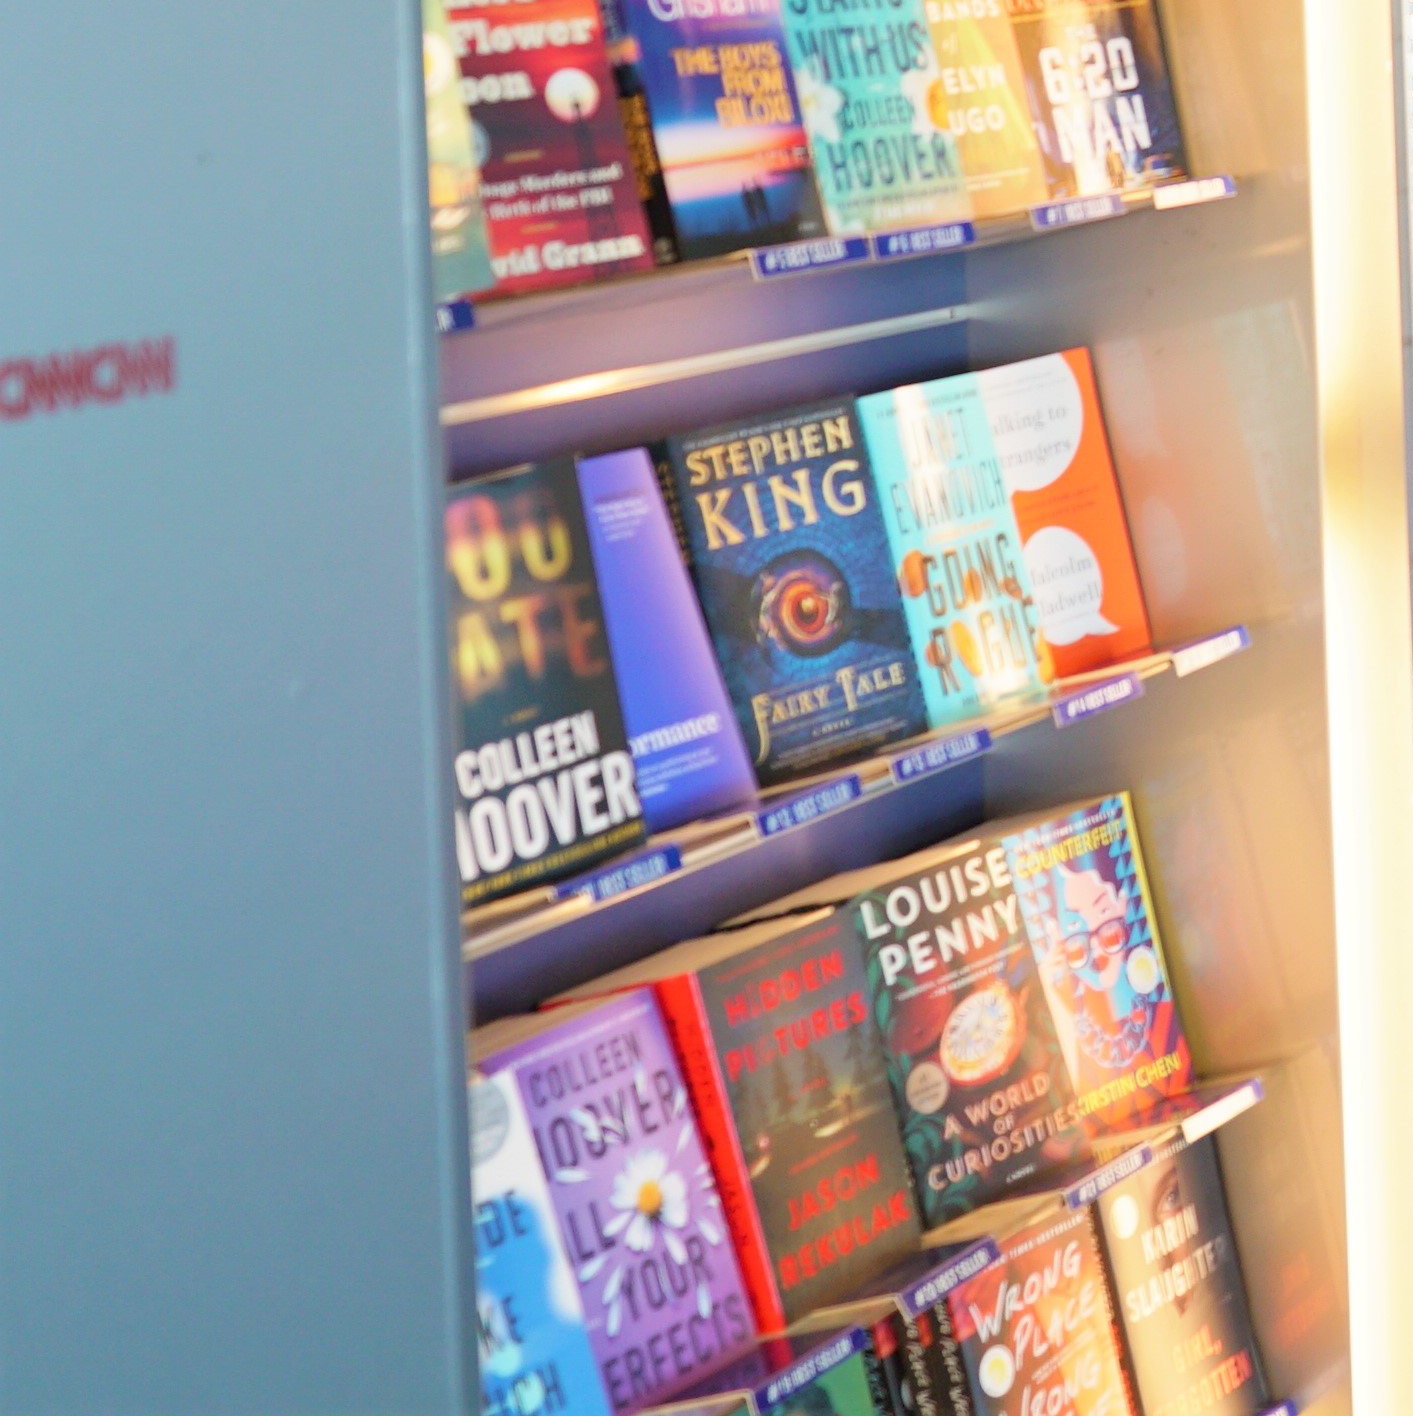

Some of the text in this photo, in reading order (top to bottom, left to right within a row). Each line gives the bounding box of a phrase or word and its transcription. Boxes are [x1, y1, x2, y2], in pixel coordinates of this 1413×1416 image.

[450, 15, 596, 57] Flower
[1037, 36, 1139, 105] 6:20
[842, 94, 917, 133] COLLEEN
[1051, 94, 1152, 164] MAN
[826, 132, 954, 194] HOOVER
[686, 414, 855, 487] STEPHEN
[1050, 405, 1067, 422] to
[696, 459, 867, 552] KING
[891, 460, 1008, 535] EVANOVICH
[924, 532, 1022, 620] GOING
[454, 709, 601, 800] COLLEEN
[1016, 819, 1124, 879] COUNTERFEIT
[860, 847, 1015, 940] LOUISE
[878, 894, 1020, 986] PENNY
[724, 947, 845, 1027] HIDDEN
[526, 1030, 644, 1108] COLLEEN
[724, 991, 868, 1083] PICTURES
[928, 1097, 1081, 1191] CURIOSITIES
[943, 1072, 1050, 1140] A WORLD
[992, 1116, 1015, 1136] OF
[785, 1152, 881, 1231] JASON
[779, 1190, 910, 1290] REKULAK
[1140, 1207, 1199, 1264] KARIN
[620, 1235, 715, 1321] YOUR
[969, 1240, 1082, 1344] WRONG
[1013, 1281, 1097, 1370] PLACE
